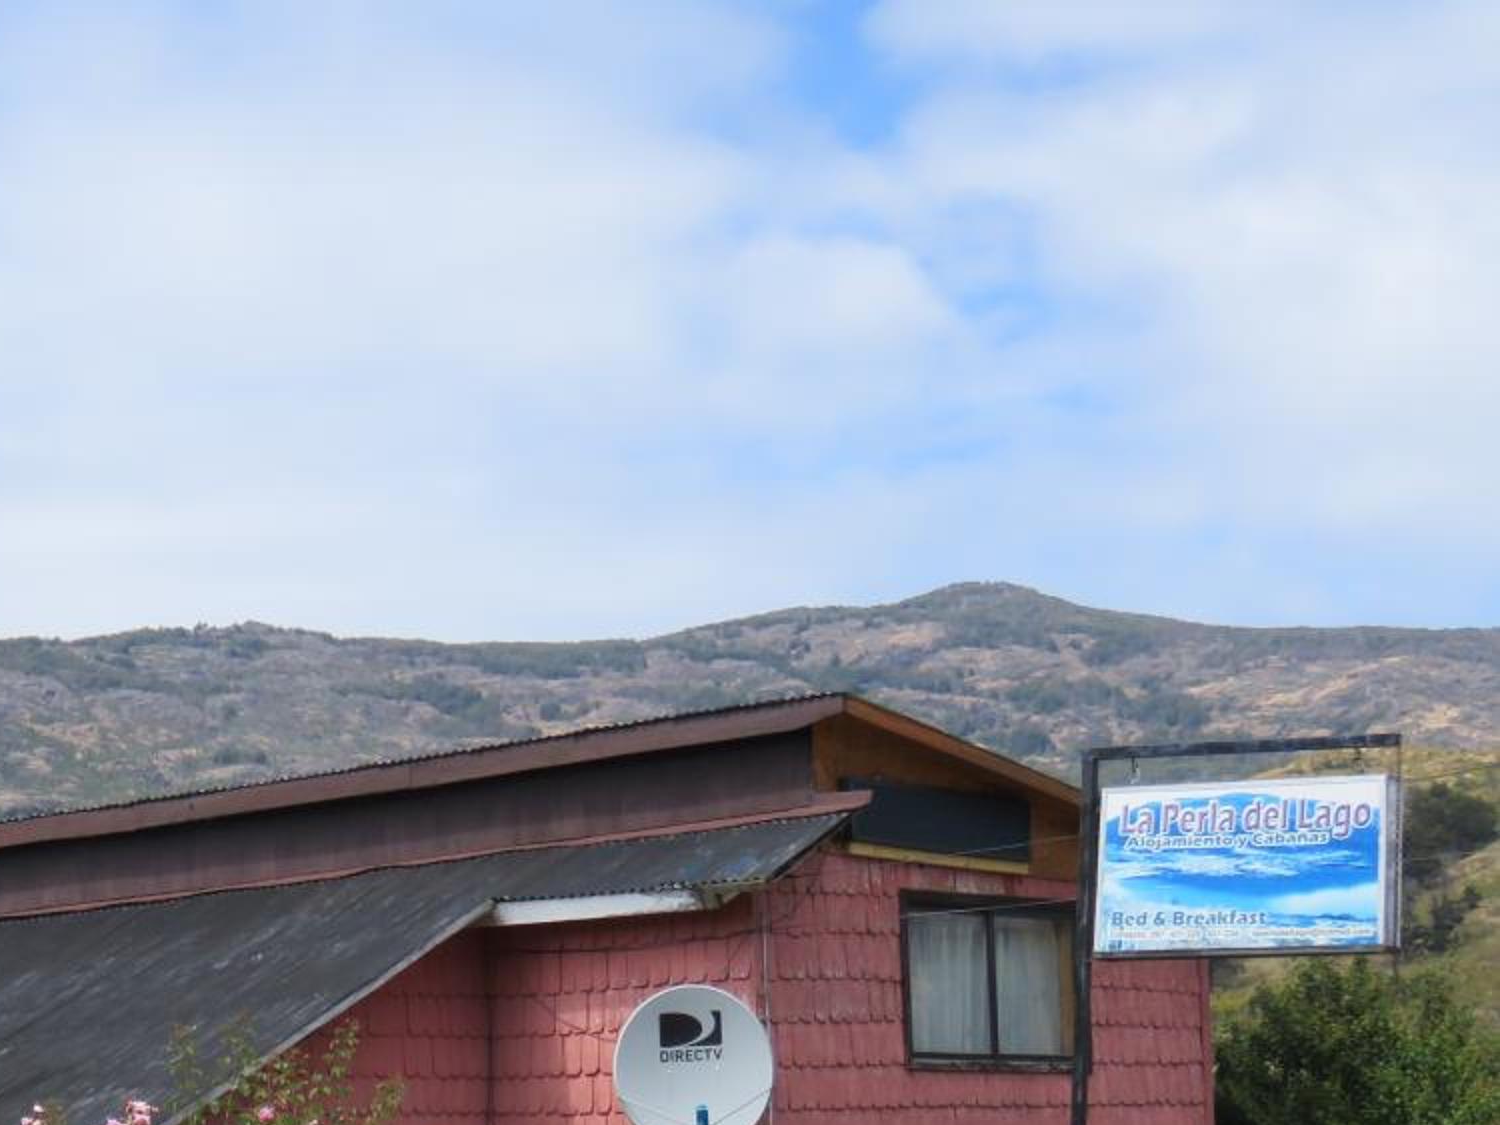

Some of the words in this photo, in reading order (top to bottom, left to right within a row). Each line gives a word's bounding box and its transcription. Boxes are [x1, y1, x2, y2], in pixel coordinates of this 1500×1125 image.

[1121, 804, 1154, 833] La
[1163, 801, 1235, 832] Perla
[1245, 799, 1288, 830] del
[1299, 798, 1372, 837] Lago
[1127, 834, 1237, 849] Alojamiento
[1111, 911, 1147, 926] Bed
[1153, 911, 1166, 925] &
[1172, 909, 1266, 926] Breakfast
[659, 1048, 723, 1063] DIRECTV
